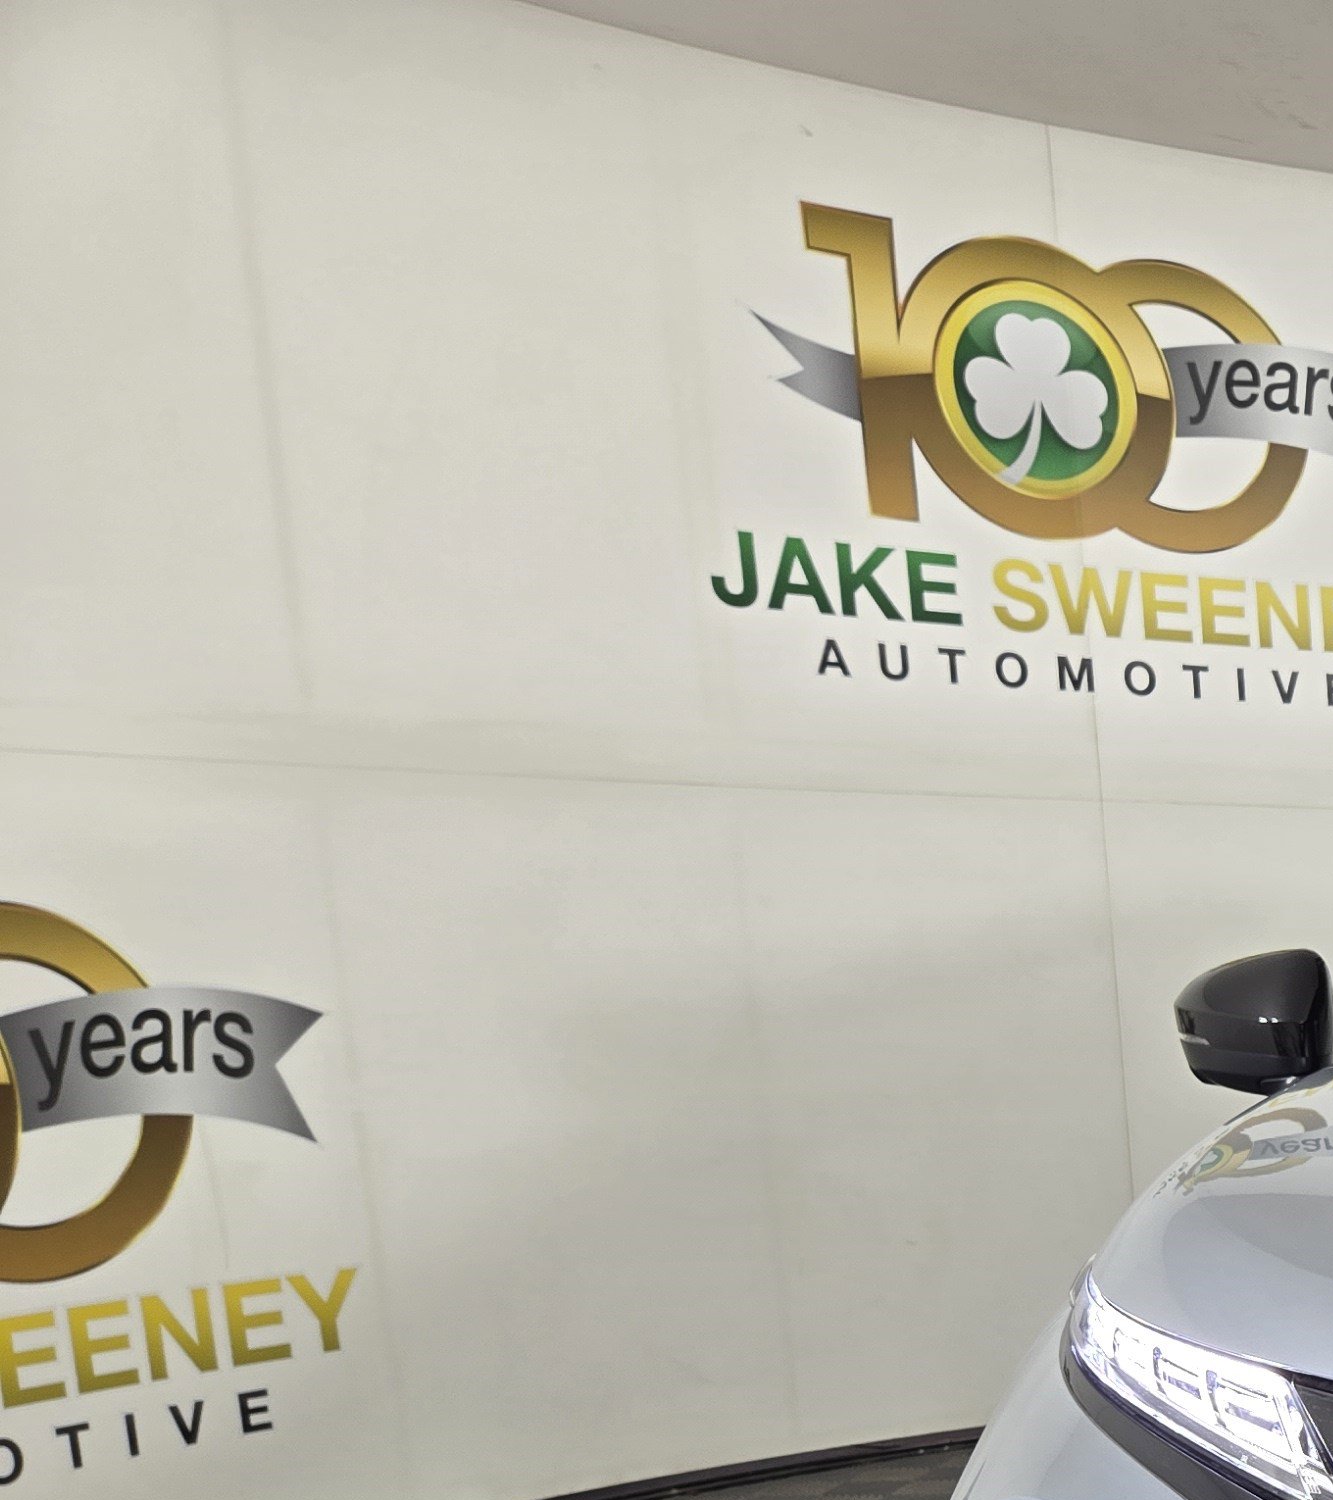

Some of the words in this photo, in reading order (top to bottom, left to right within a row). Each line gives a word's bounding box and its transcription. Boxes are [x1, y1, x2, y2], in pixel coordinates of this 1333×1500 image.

[799, 200, 1308, 553] 100
[710, 529, 965, 627] JAKE
[27, 1007, 255, 1111] years
